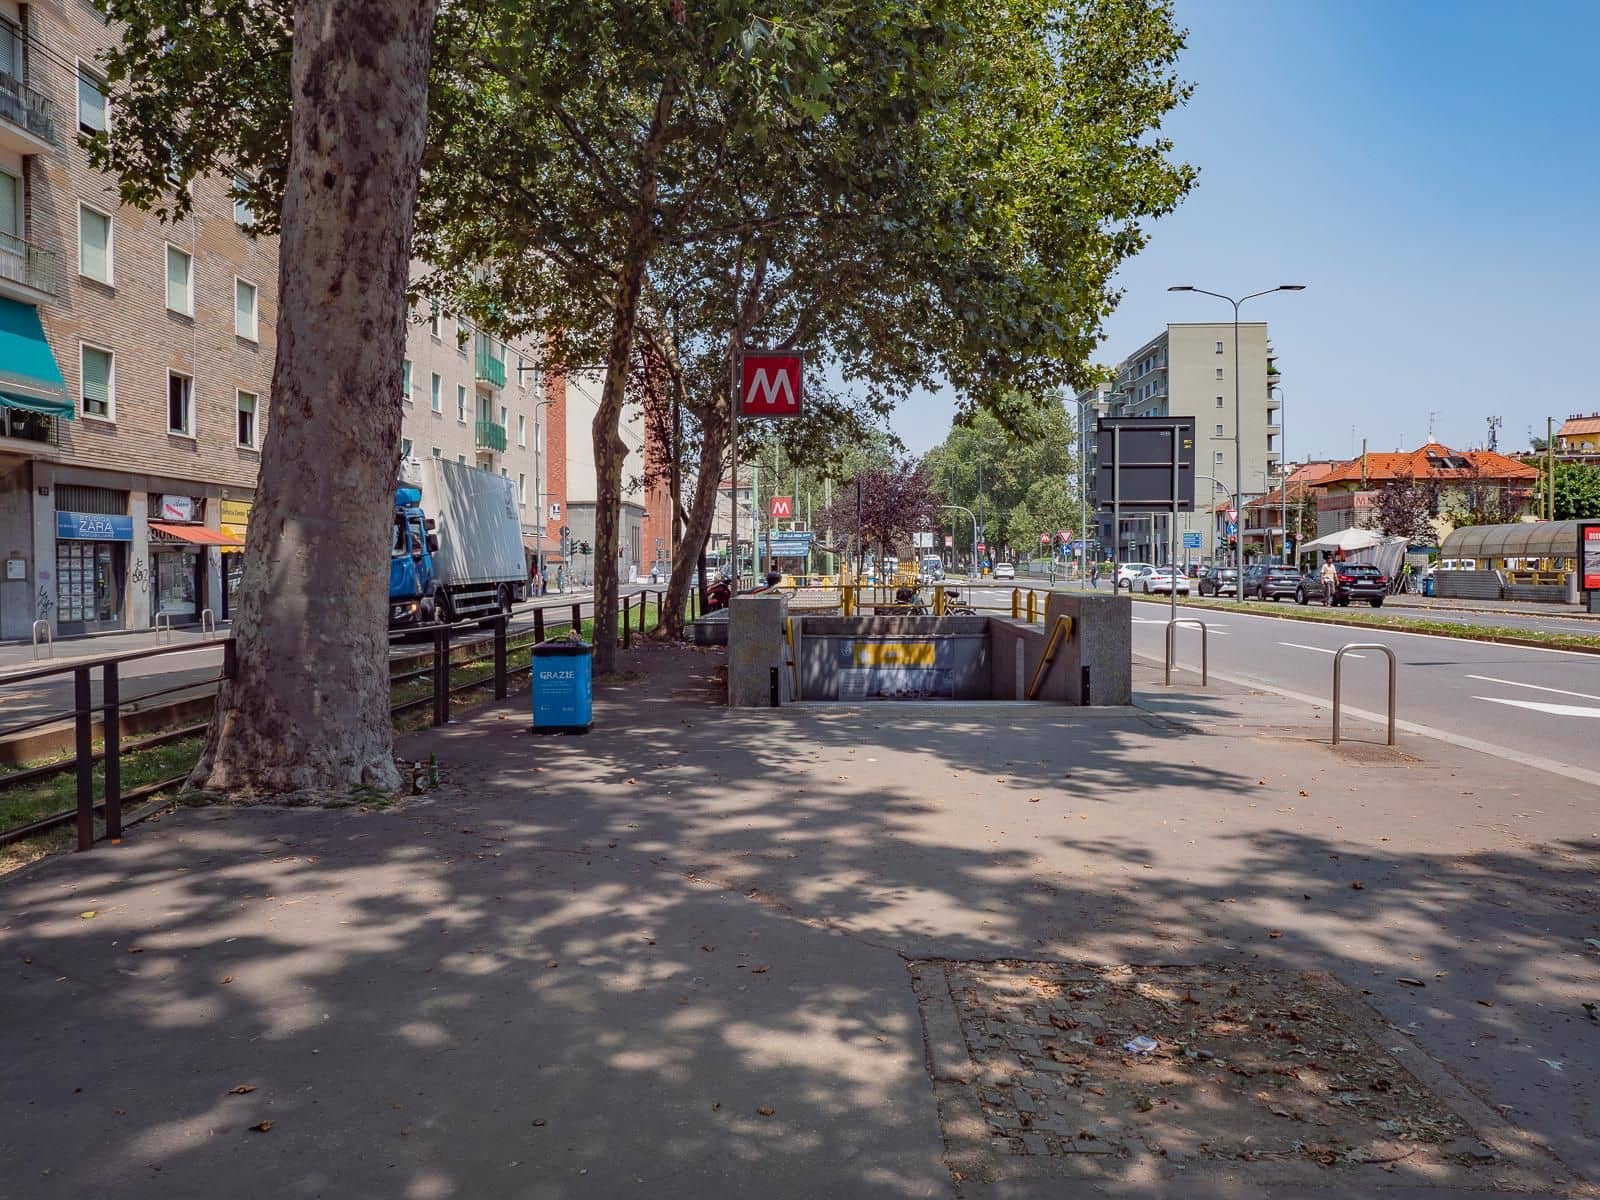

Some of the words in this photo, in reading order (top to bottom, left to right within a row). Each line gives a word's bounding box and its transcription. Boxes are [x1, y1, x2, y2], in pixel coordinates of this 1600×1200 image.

[745, 368, 795, 404] M
[772, 502, 790, 514] M
[80, 519, 113, 532] ZARA
[539, 671, 575, 680] GRAZIE
